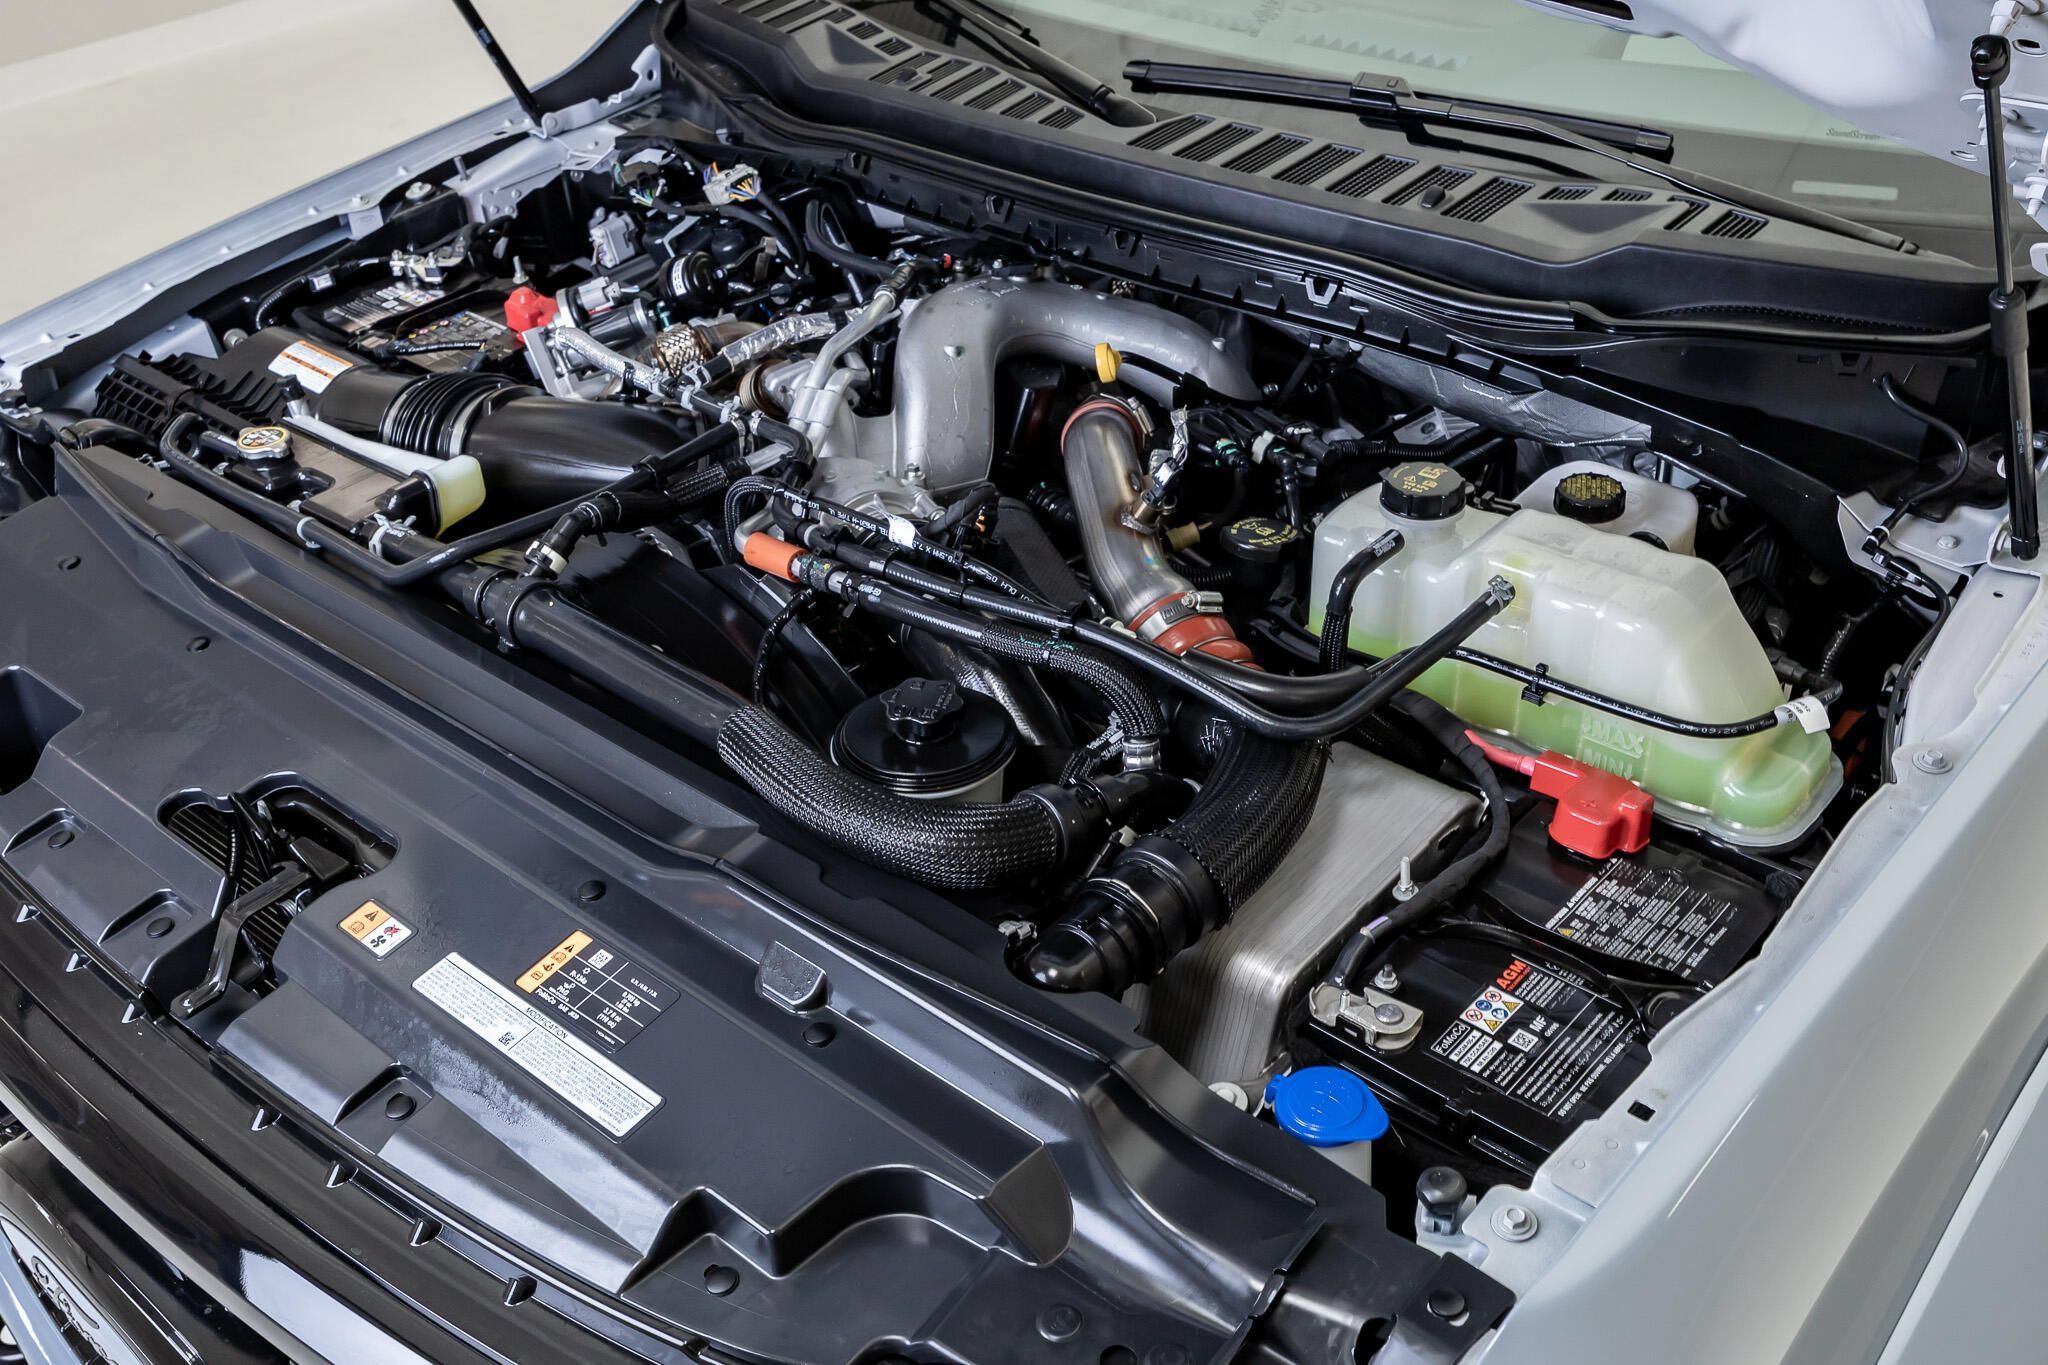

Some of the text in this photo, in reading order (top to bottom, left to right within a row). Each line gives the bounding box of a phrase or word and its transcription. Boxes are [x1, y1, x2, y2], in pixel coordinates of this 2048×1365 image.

[836, 511, 851, 521] TYPE
[1590, 725, 1643, 753] MAX
[1583, 749, 1623, 774] MIN
[1496, 959, 1530, 988] AGM
[535, 989, 557, 1005] FoMoCo
[525, 1007, 568, 1039] MODIFICATION
[1530, 1015, 1548, 1032] MF
[1434, 1023, 1466, 1053] FoMoCo
